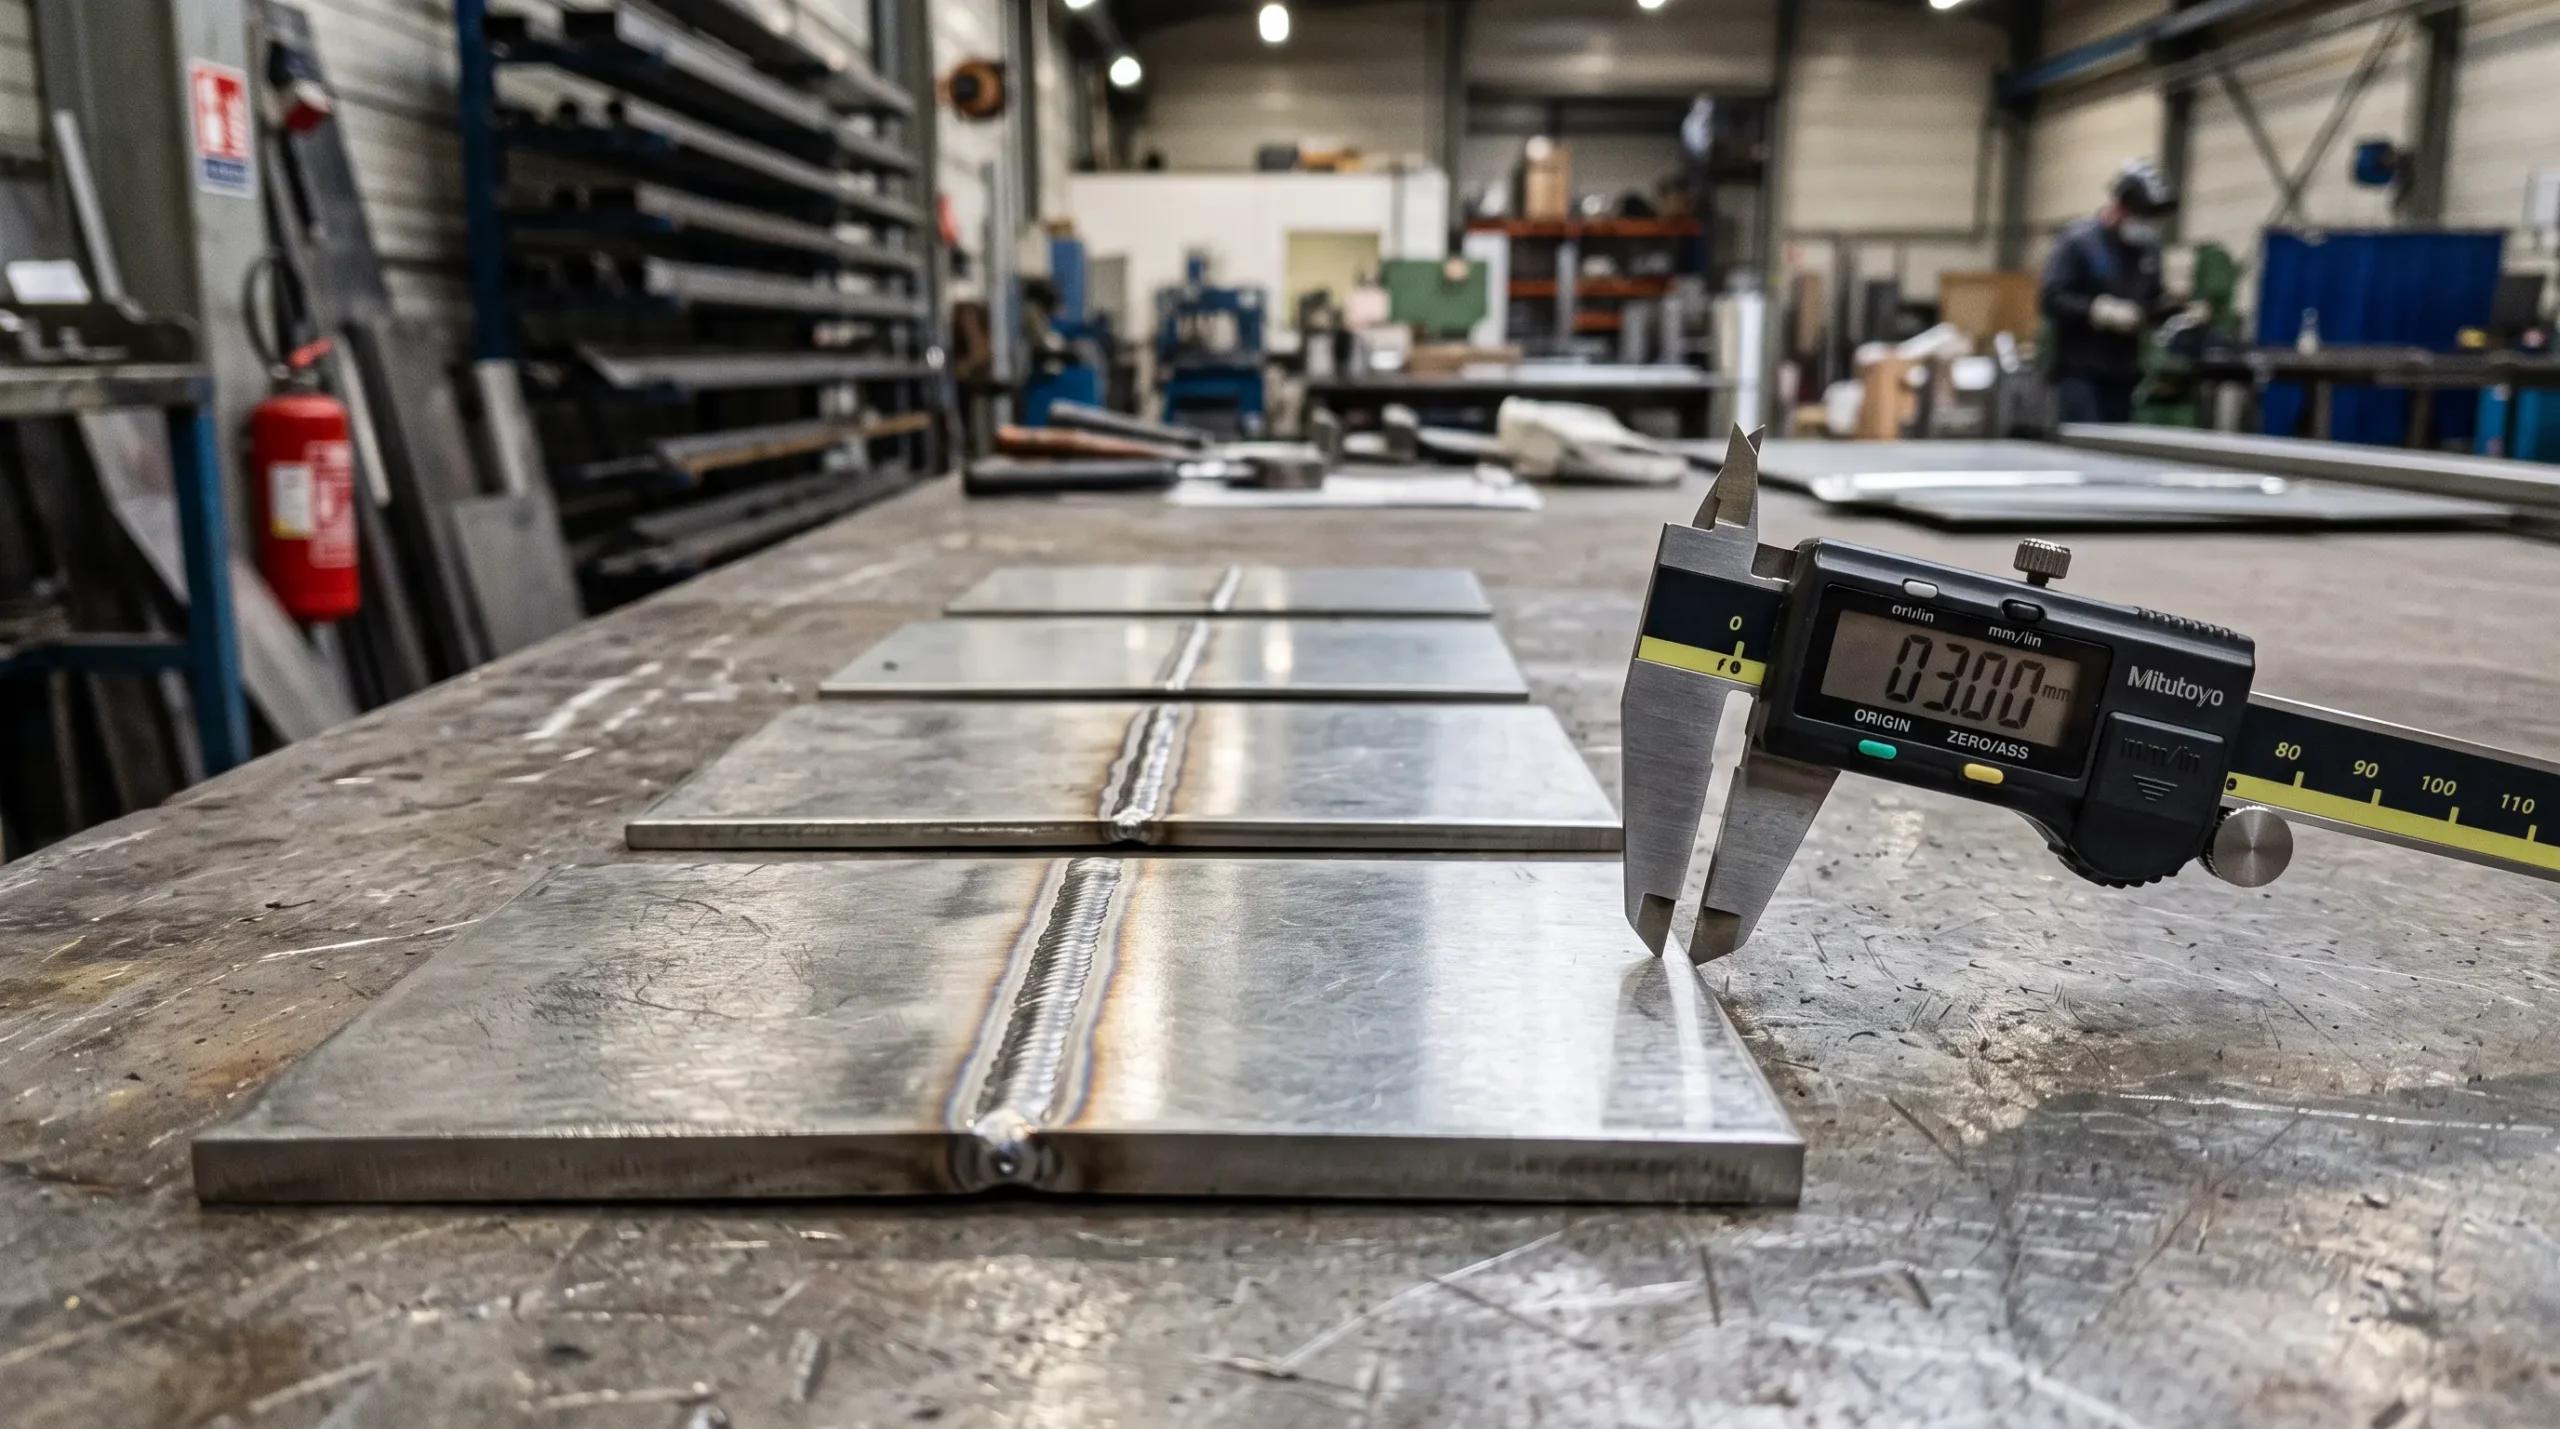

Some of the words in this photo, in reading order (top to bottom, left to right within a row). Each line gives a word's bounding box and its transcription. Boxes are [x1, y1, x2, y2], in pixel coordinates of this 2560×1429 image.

[1729, 615, 1742, 631] 0
[1885, 634, 2046, 730] 03.00
[2042, 684, 2072, 702] mm
[2127, 665, 2224, 707] Mitutoyo
[1854, 709, 1911, 733] ORIGIN
[1946, 730, 2029, 760] ZERO/ASS
[2119, 737, 2202, 775] mm/in
[2275, 742, 2301, 761] 80
[2353, 760, 2379, 779] 90
[2421, 775, 2457, 797] 100
[2501, 794, 2535, 815] 110
